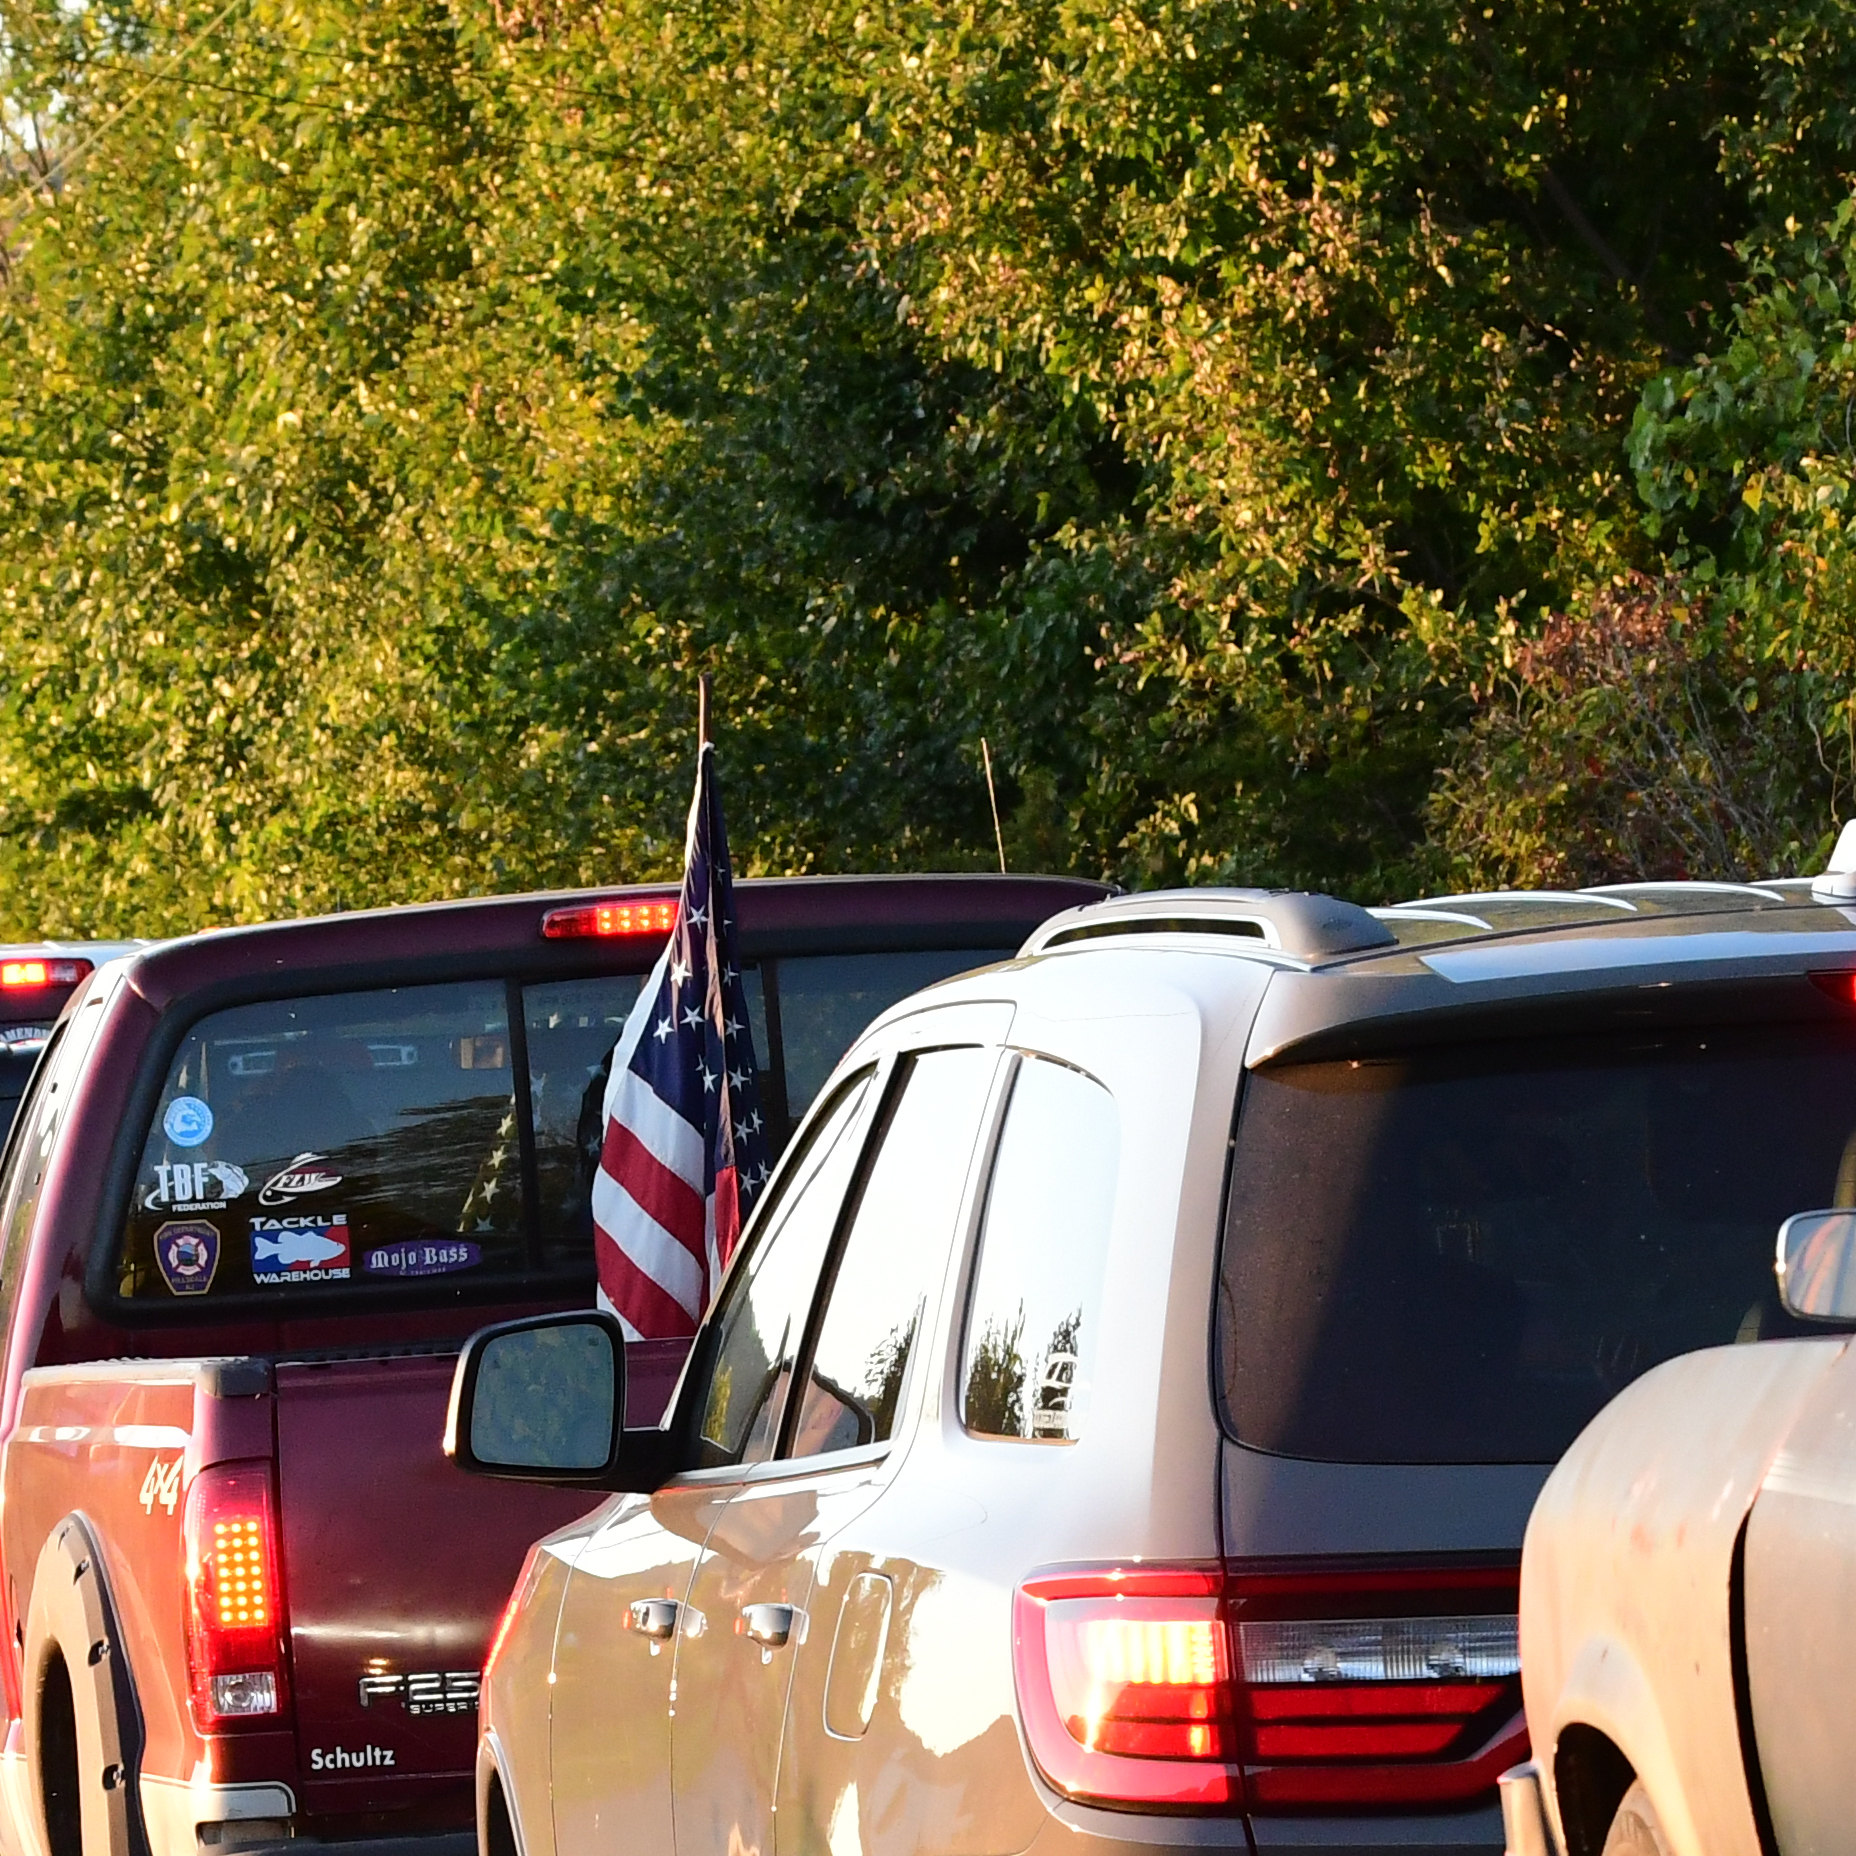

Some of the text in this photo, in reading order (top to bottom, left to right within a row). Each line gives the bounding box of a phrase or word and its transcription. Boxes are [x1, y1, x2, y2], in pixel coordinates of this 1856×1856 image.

[154, 1162, 209, 1202] TBF
[172, 1201, 227, 1213] FEDERATION
[249, 1214, 348, 1231] TACKLE
[370, 1244, 469, 1271] Mojo Bass
[253, 1268, 351, 1285] WAREHOUSE
[310, 1745, 396, 1771] Schultz
